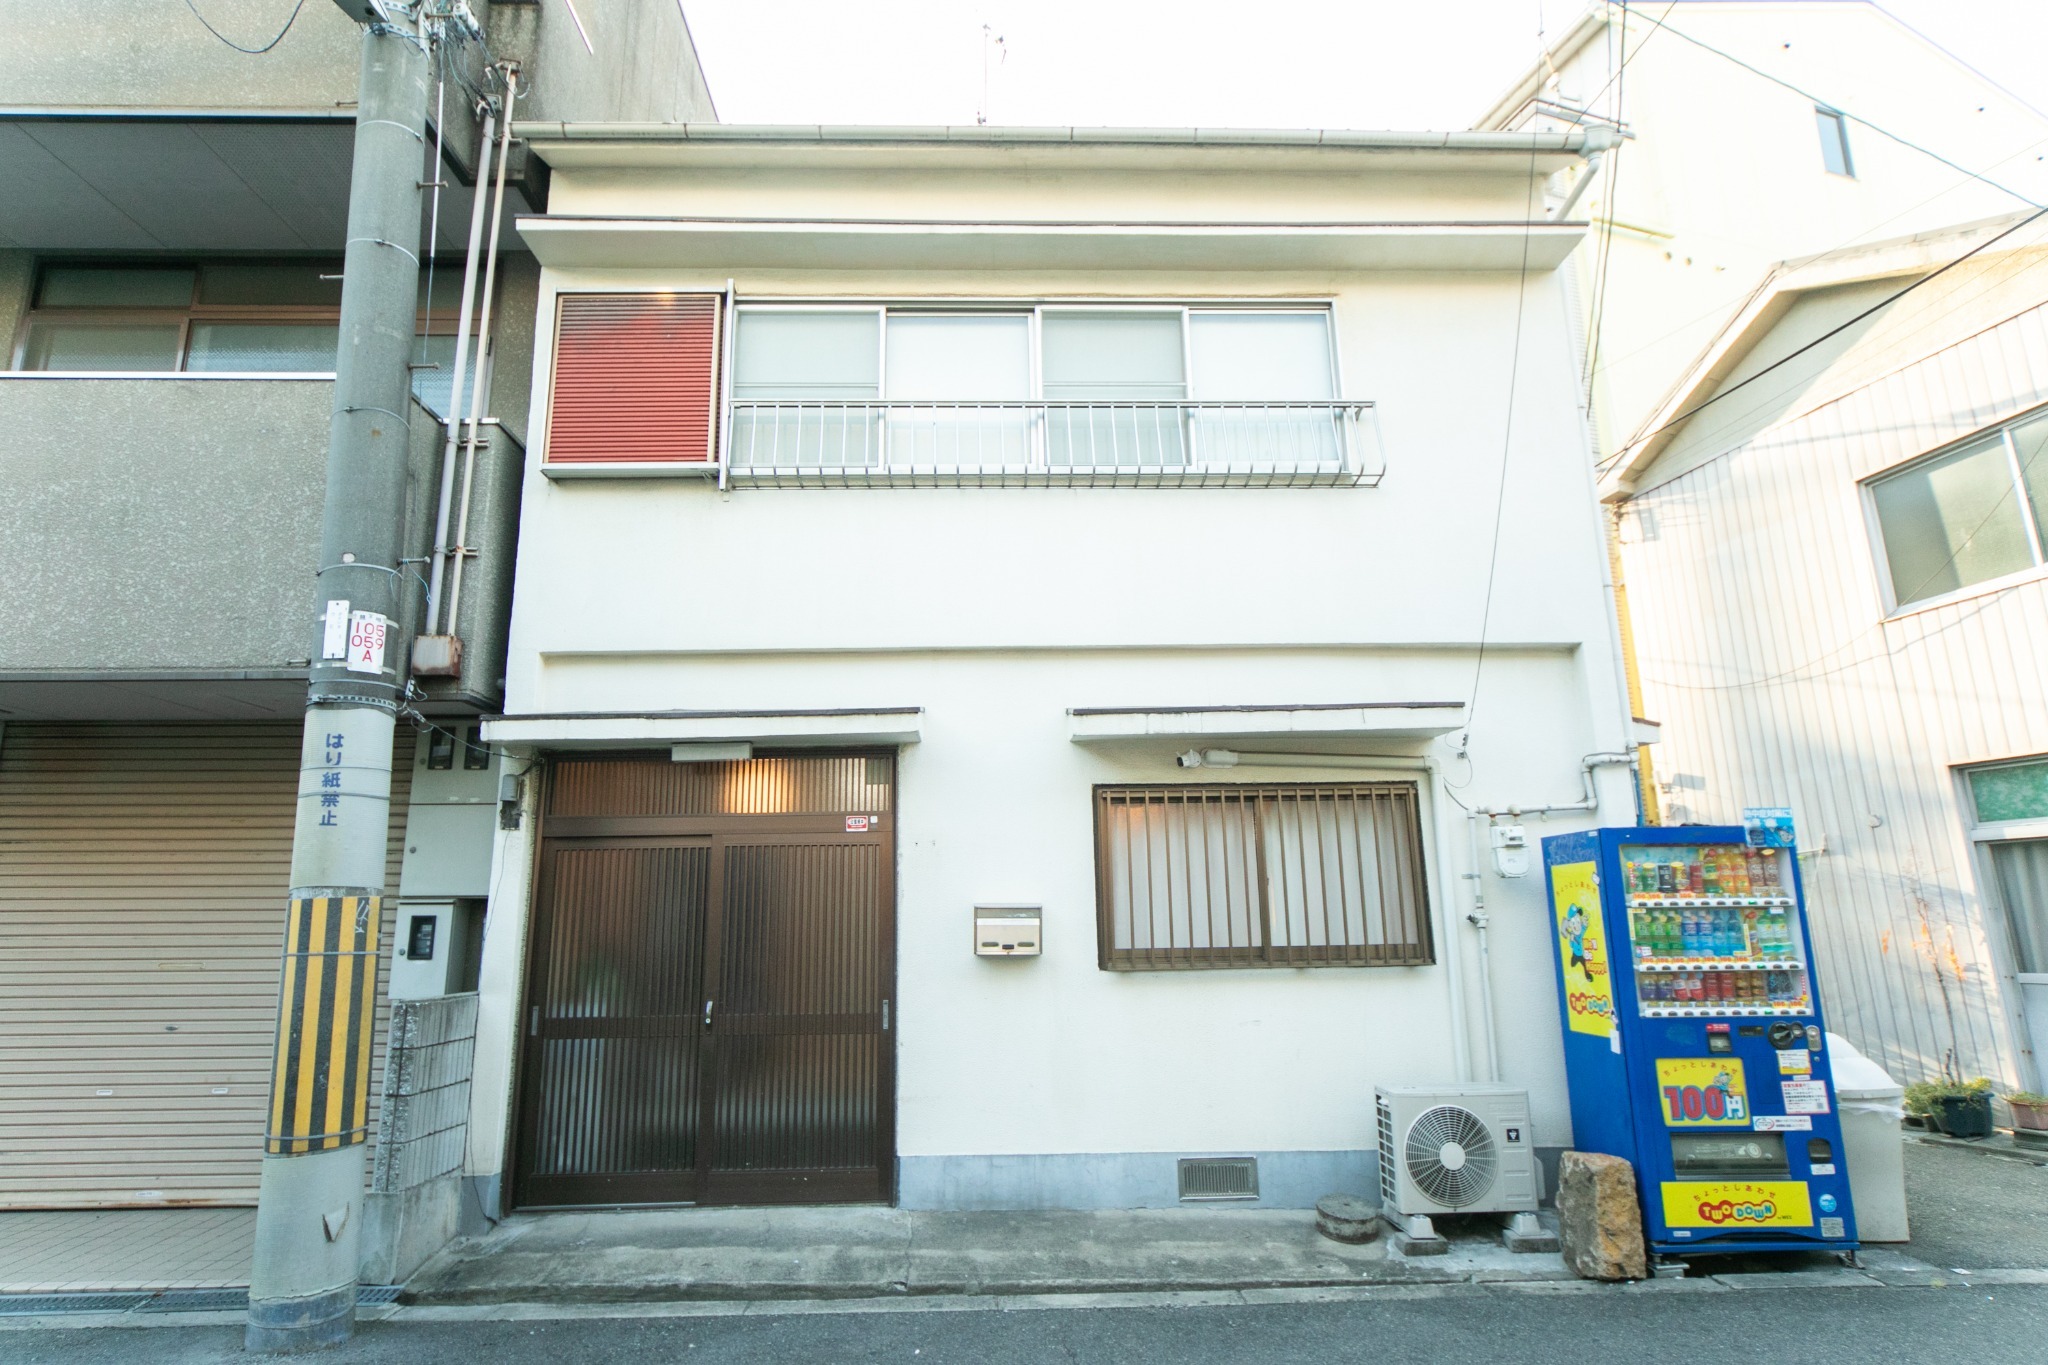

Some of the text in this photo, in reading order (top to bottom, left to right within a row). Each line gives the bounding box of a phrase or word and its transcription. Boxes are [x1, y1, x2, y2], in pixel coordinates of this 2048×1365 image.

[356, 621, 384, 638] 105
[351, 635, 384, 650] 059
[362, 650, 372, 662] A
[319, 733, 344, 827] はり紙禁止
[1663, 1061, 1738, 1077] ちょっとしあわせ
[1664, 1086, 1745, 1120] 100円
[1693, 1184, 1776, 1202] ちょっとしあわせ
[1702, 1203, 1732, 1220] TWO
[1734, 1203, 1773, 1219] DOWN
